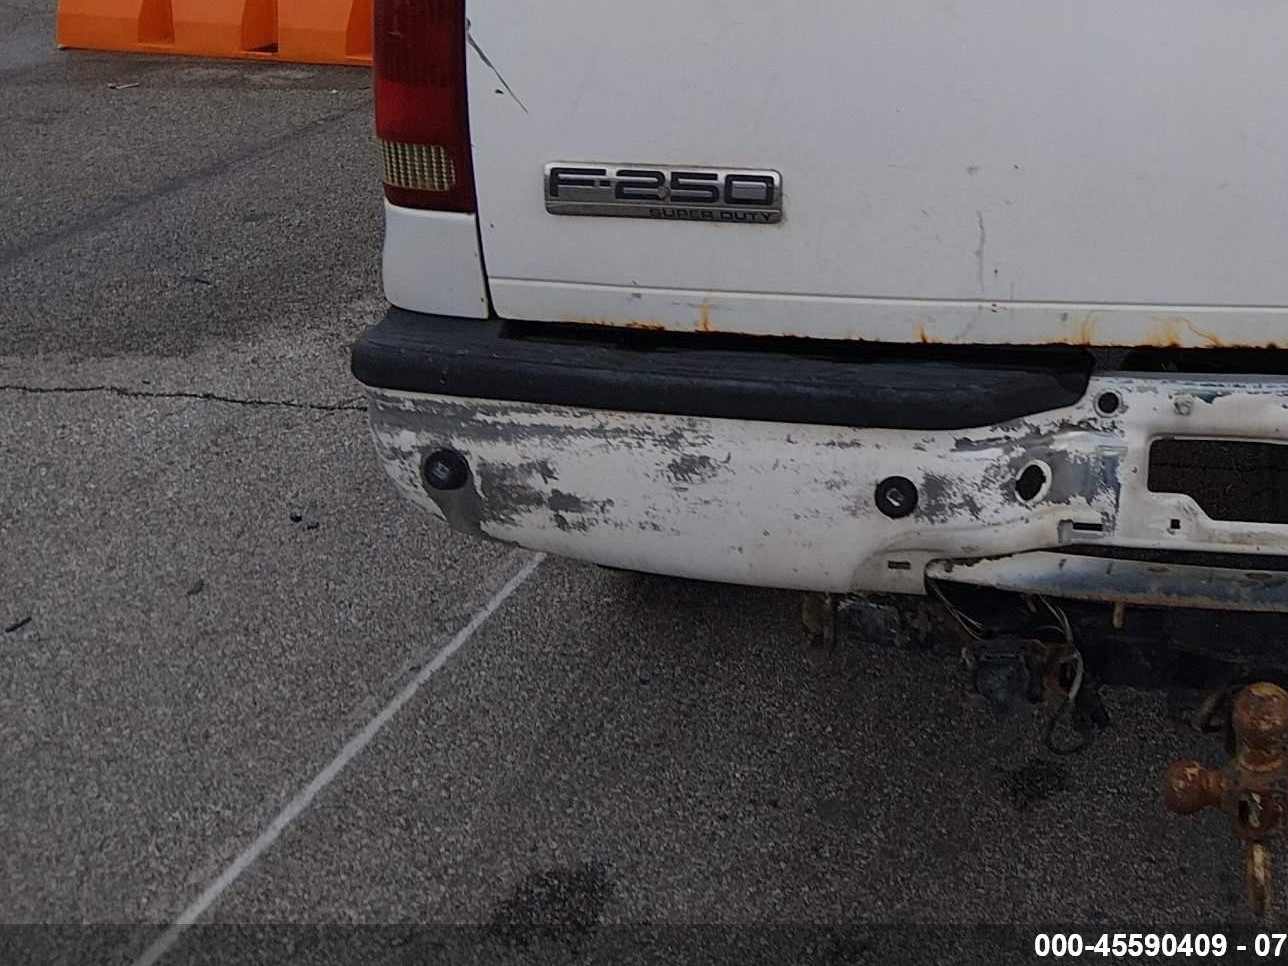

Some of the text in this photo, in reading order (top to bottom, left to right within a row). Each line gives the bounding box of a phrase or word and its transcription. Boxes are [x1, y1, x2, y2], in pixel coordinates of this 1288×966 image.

[548, 166, 776, 206] F-250
[648, 208, 774, 222] SUPER DUTY
